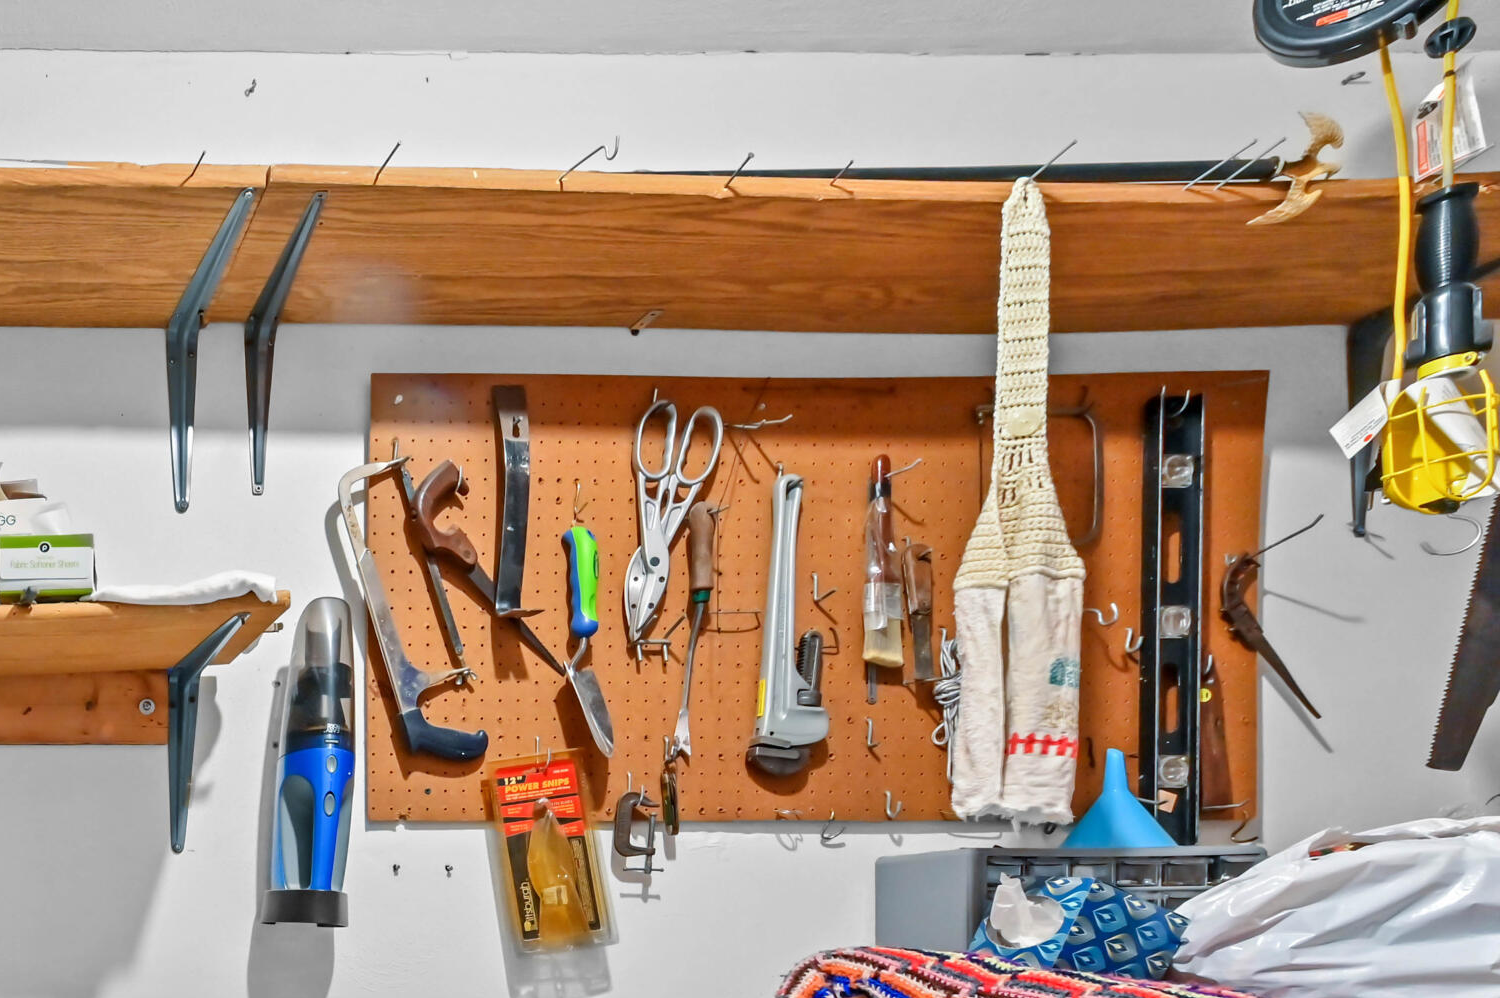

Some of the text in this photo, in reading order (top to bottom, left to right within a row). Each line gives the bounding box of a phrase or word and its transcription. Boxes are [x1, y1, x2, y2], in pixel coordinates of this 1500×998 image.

[504, 775, 522, 786] 12"
[505, 778, 570, 793] POWER SNIPS
